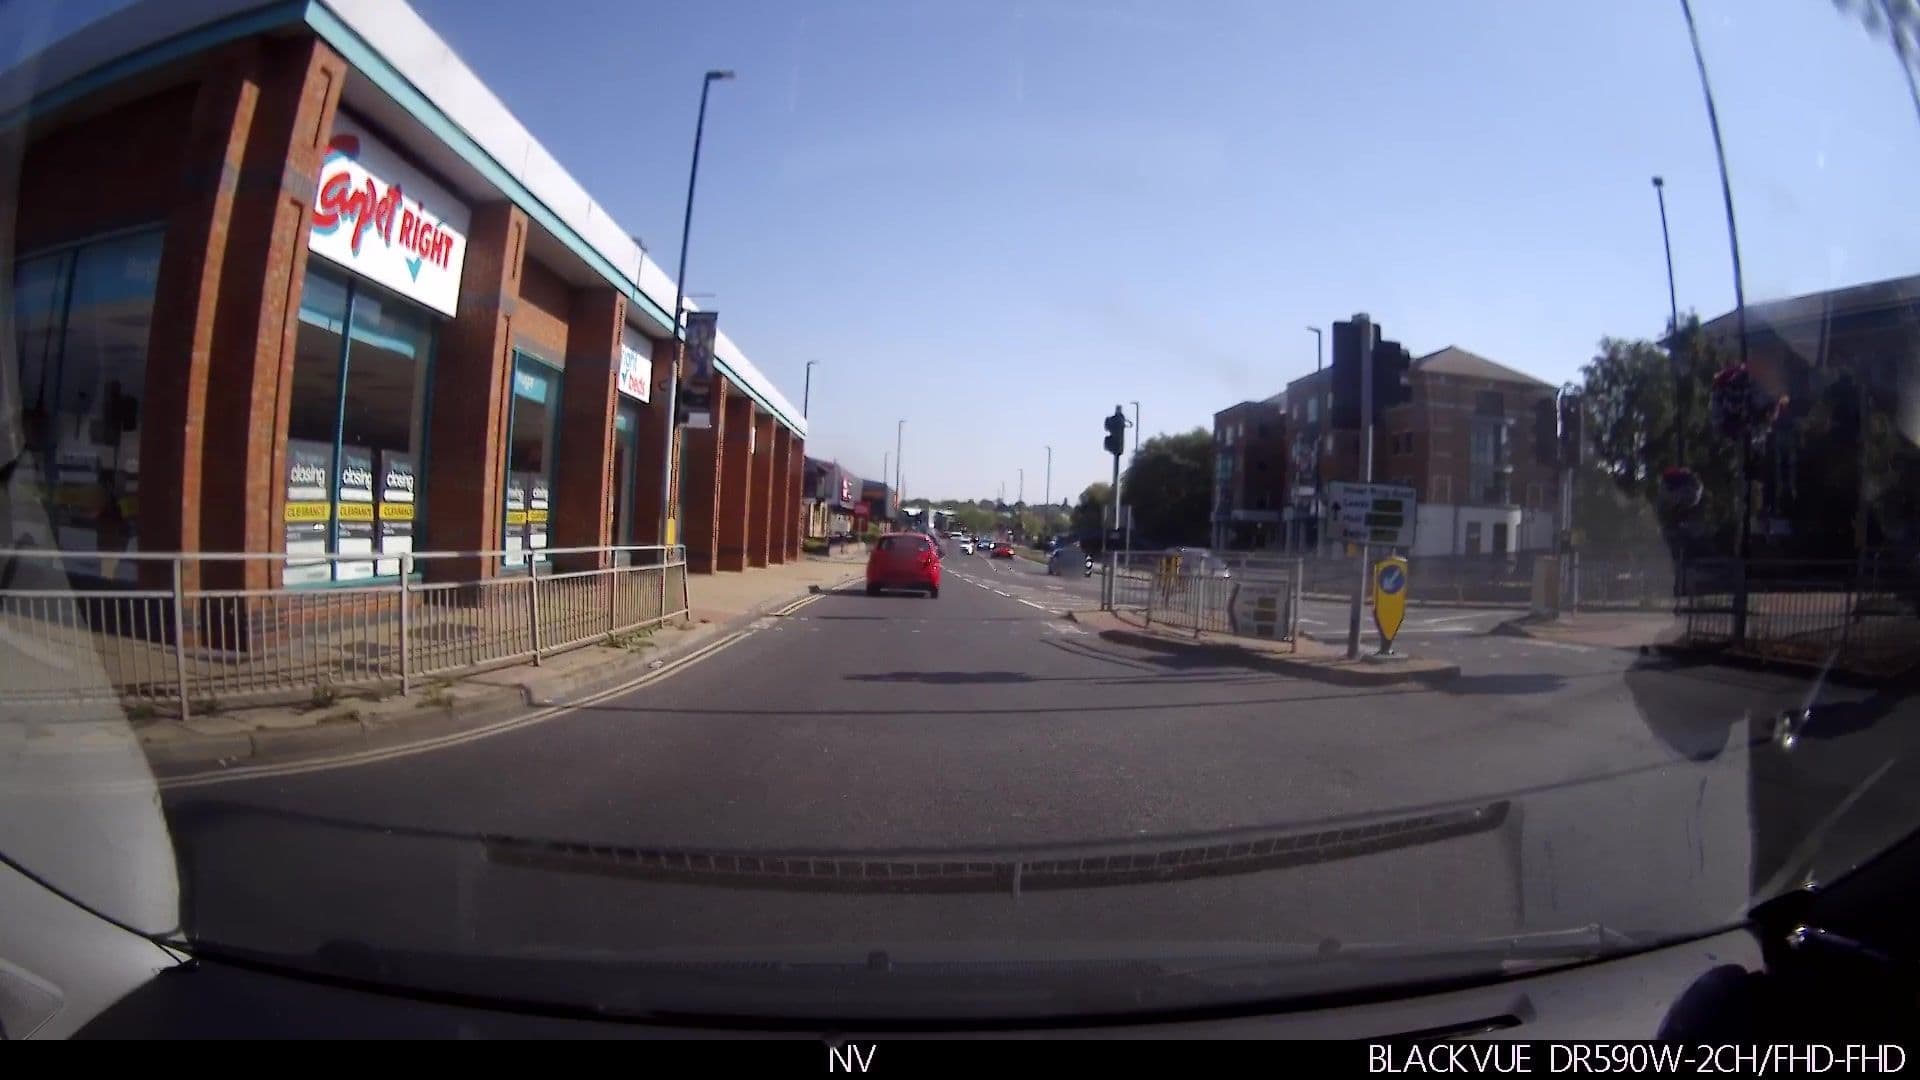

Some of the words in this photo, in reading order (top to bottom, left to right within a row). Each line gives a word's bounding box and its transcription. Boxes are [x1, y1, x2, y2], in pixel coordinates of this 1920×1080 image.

[399, 201, 454, 272] RIGHT
[291, 463, 326, 487] closing
[342, 466, 373, 490] closing
[386, 470, 414, 492] closing
